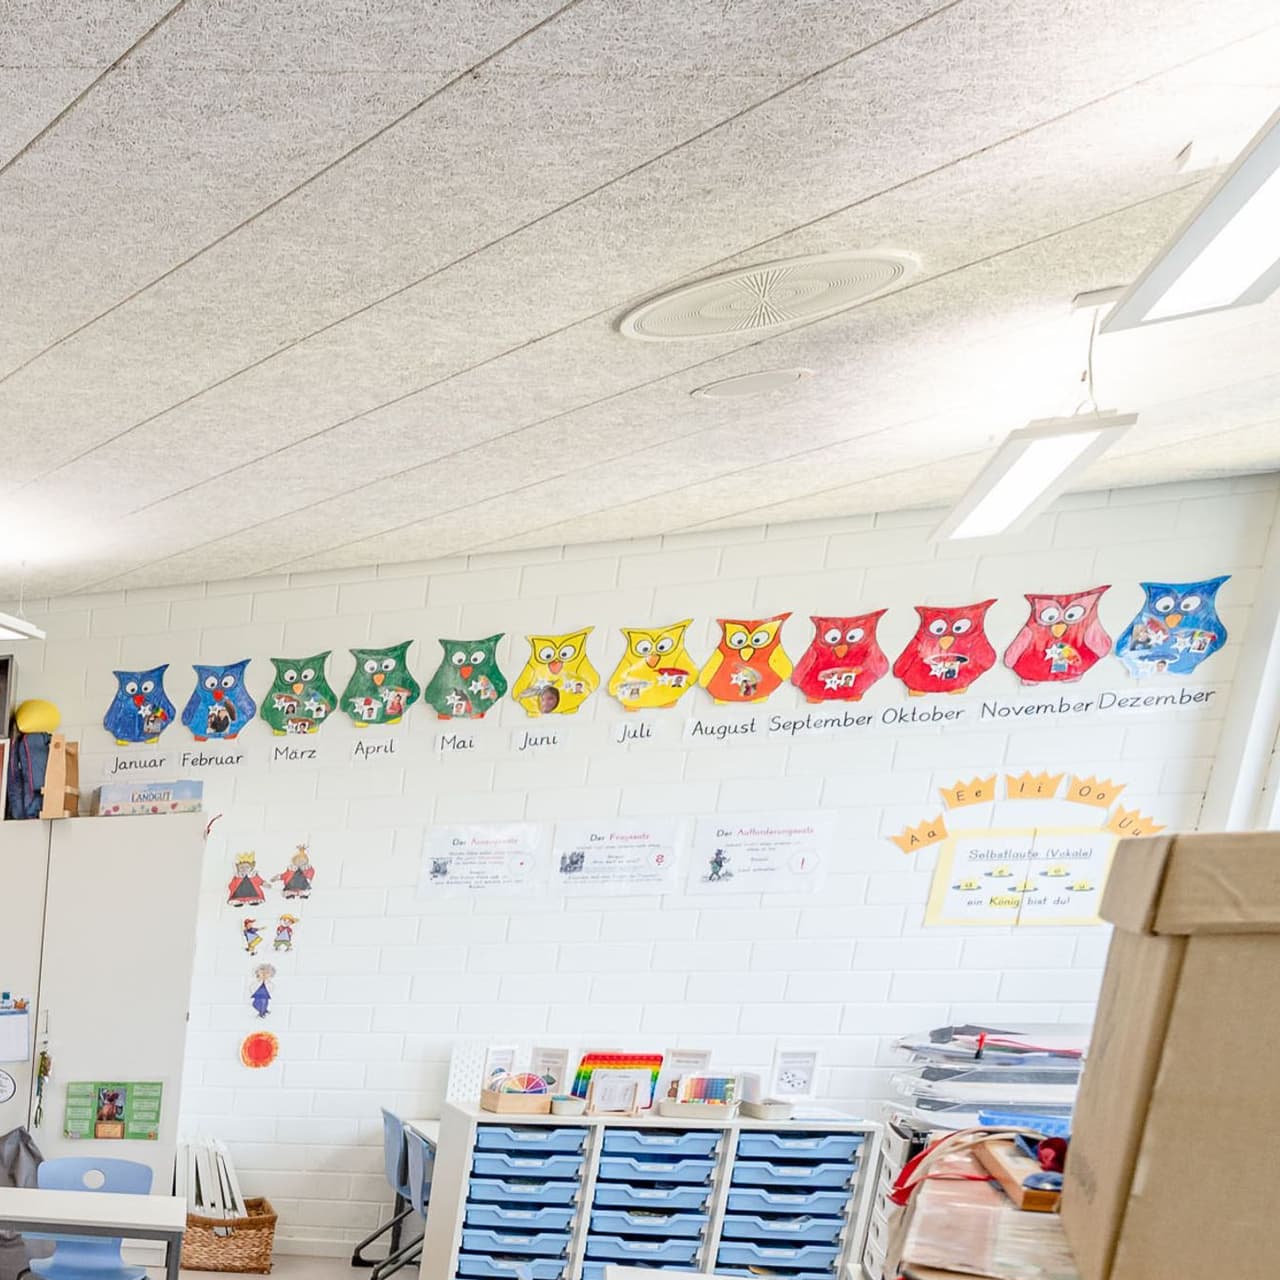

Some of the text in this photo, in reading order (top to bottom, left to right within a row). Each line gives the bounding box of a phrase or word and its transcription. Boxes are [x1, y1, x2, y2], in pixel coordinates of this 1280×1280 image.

[981, 697, 1094, 719] November
[1098, 688, 1217, 711] Dezember
[768, 710, 873, 736] September
[881, 705, 966, 725] Oktober
[617, 723, 652, 743] Juli
[691, 718, 757, 740] August
[354, 738, 396, 760] April
[440, 735, 475, 750] Mai
[519, 731, 559, 751] Juni
[181, 752, 245, 768] Februar
[274, 746, 318, 761] März
[111, 756, 168, 774] Januar
[131, 791, 172, 803] LANDGUT
[956, 789, 983, 802] E e
[1079, 785, 1106, 801] O o
[1118, 816, 1133, 830] U
[910, 829, 937, 846] A a
[968, 847, 1094, 861] Selbstlaute (Vokale)
[967, 898, 984, 906] ein
[989, 896, 1021, 909] König
[1027, 896, 1048, 906] bist
